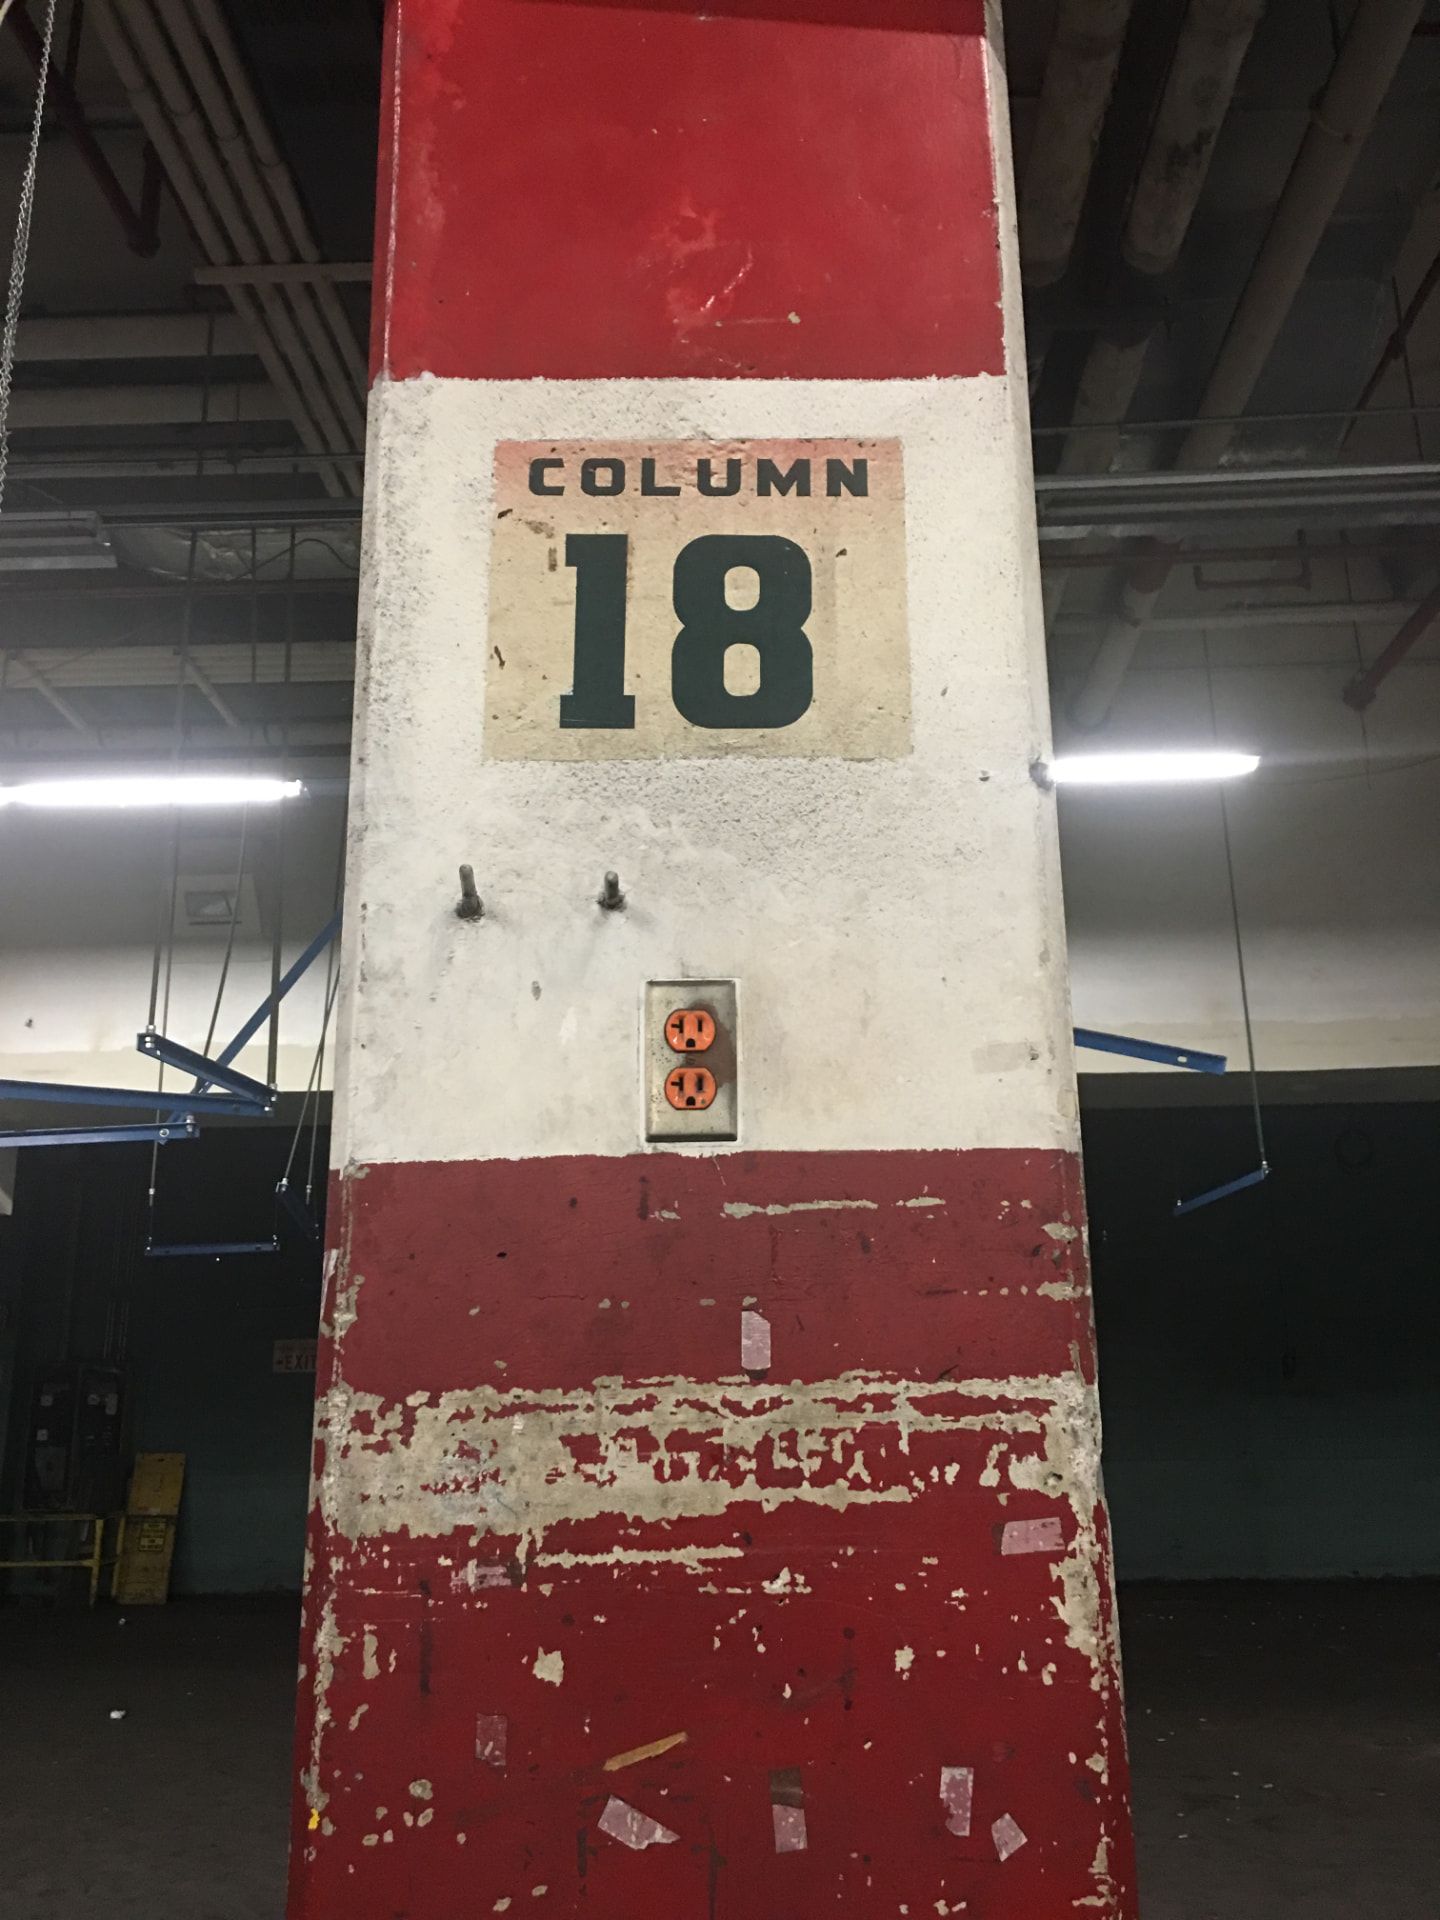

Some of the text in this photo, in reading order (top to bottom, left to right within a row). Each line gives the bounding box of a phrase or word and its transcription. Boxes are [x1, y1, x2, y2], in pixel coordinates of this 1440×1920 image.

[528, 457, 869, 498] COLUMN
[559, 533, 814, 730] 18
[284, 1354, 317, 1370] EXIT
